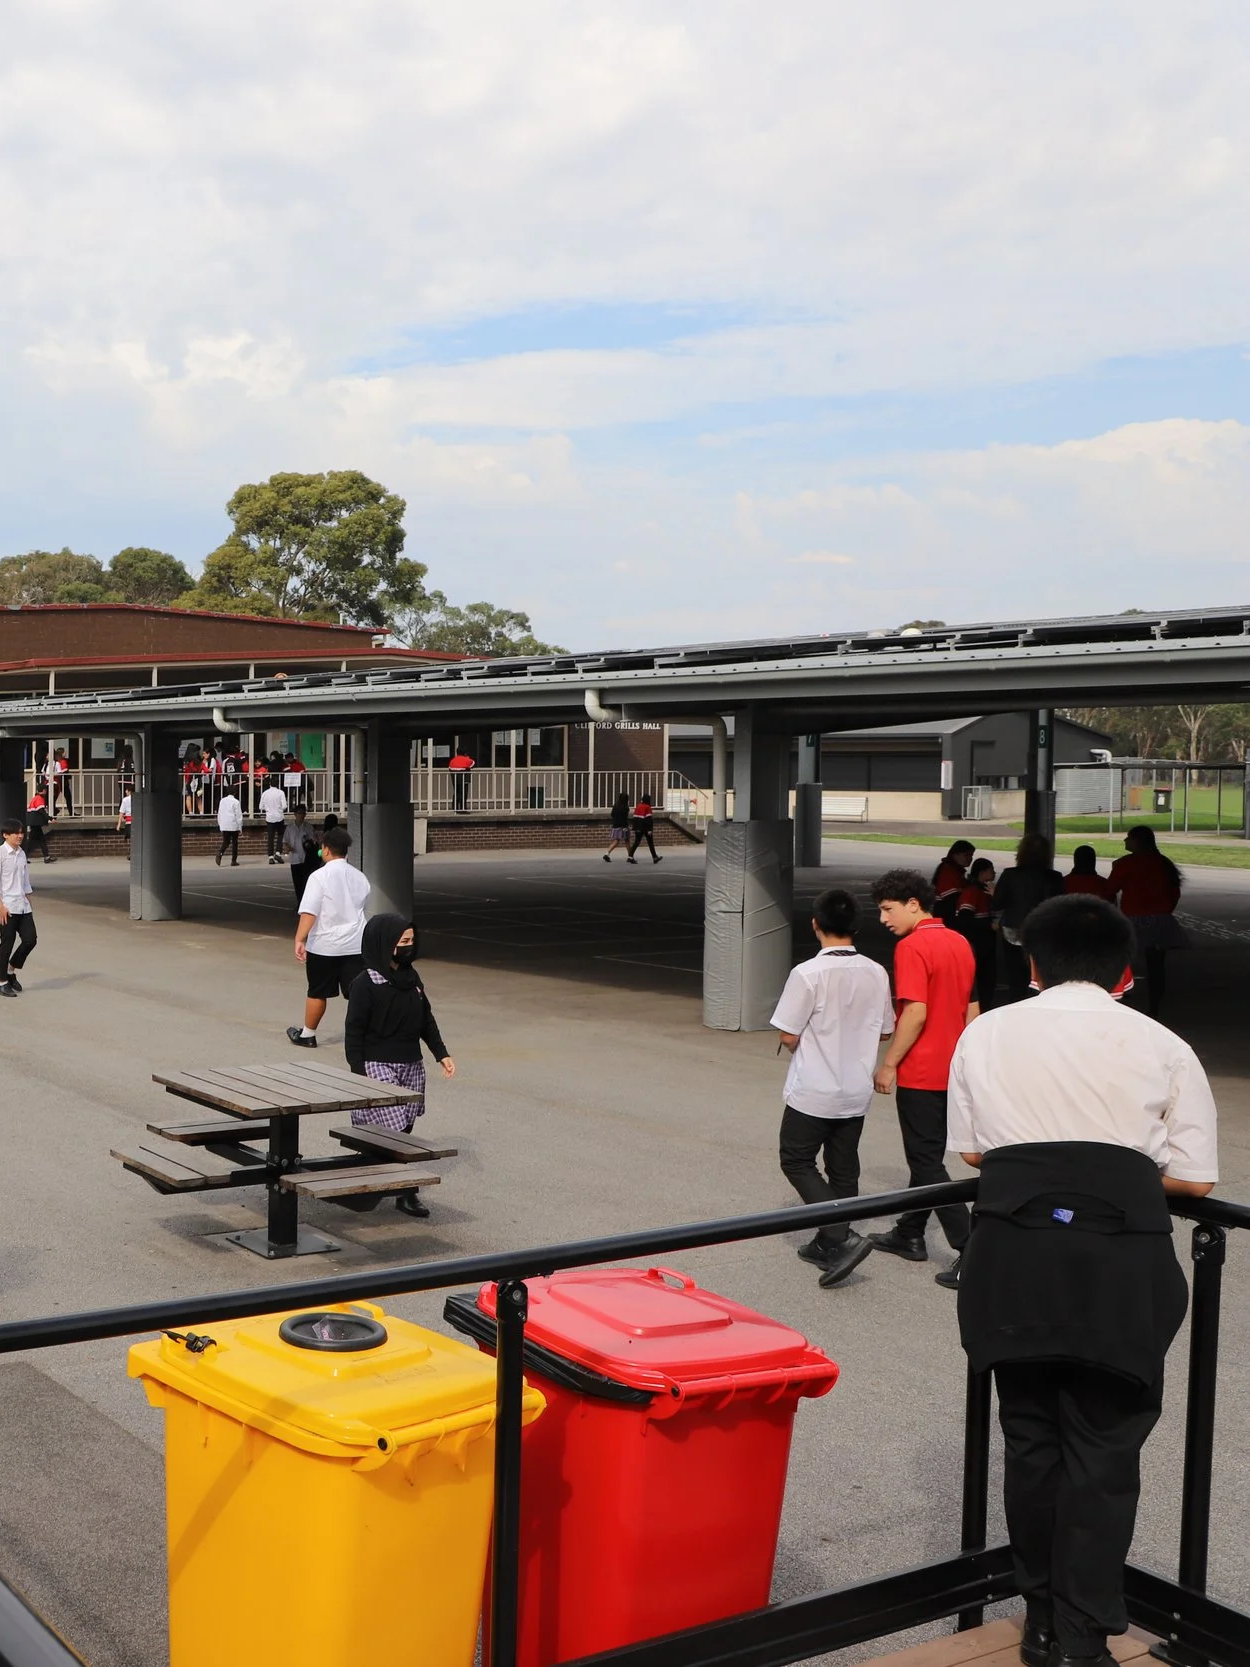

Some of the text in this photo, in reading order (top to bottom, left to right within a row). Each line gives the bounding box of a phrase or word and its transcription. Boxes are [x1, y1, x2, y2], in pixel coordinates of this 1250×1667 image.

[575, 722, 612, 730] CLIFORD
[615, 722, 640, 730] GRILLS
[1040, 730, 1045, 743] 8
